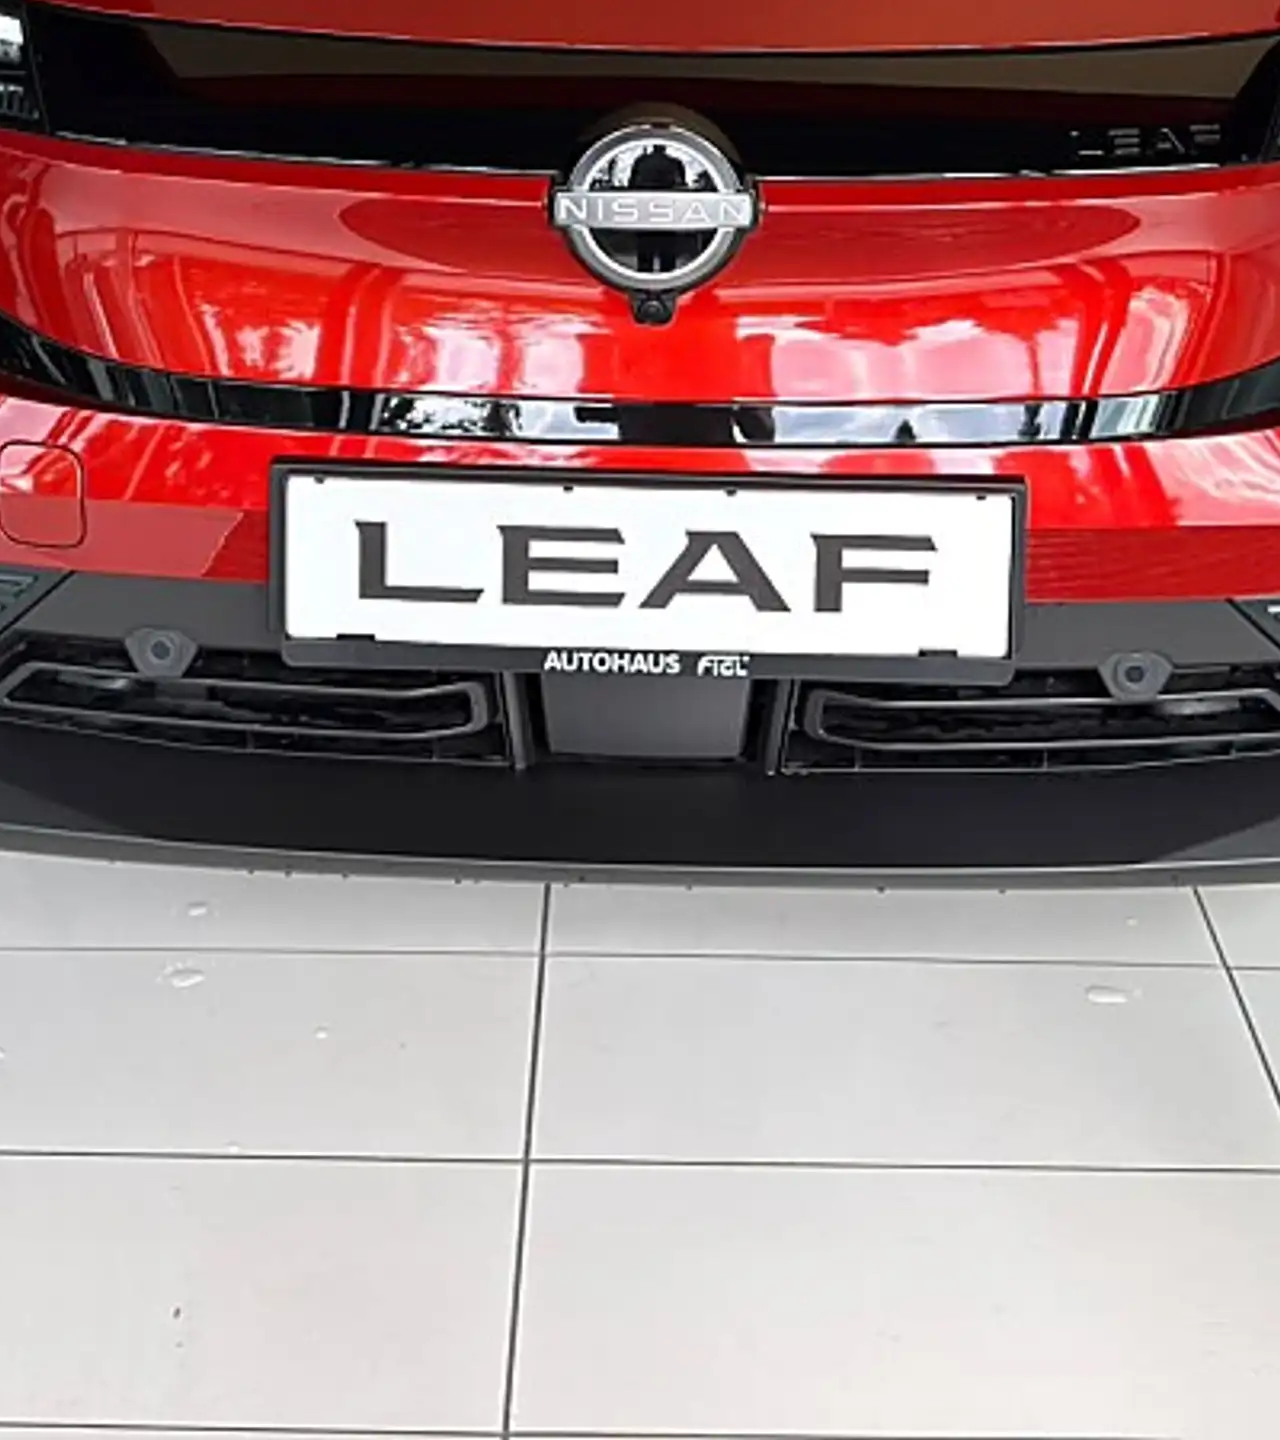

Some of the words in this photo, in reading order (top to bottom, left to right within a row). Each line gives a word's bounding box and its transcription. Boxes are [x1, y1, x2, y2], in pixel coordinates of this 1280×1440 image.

[559, 197, 747, 224] NISSAN
[354, 520, 939, 613] LEAF
[543, 650, 682, 674] AUTOHAUS
